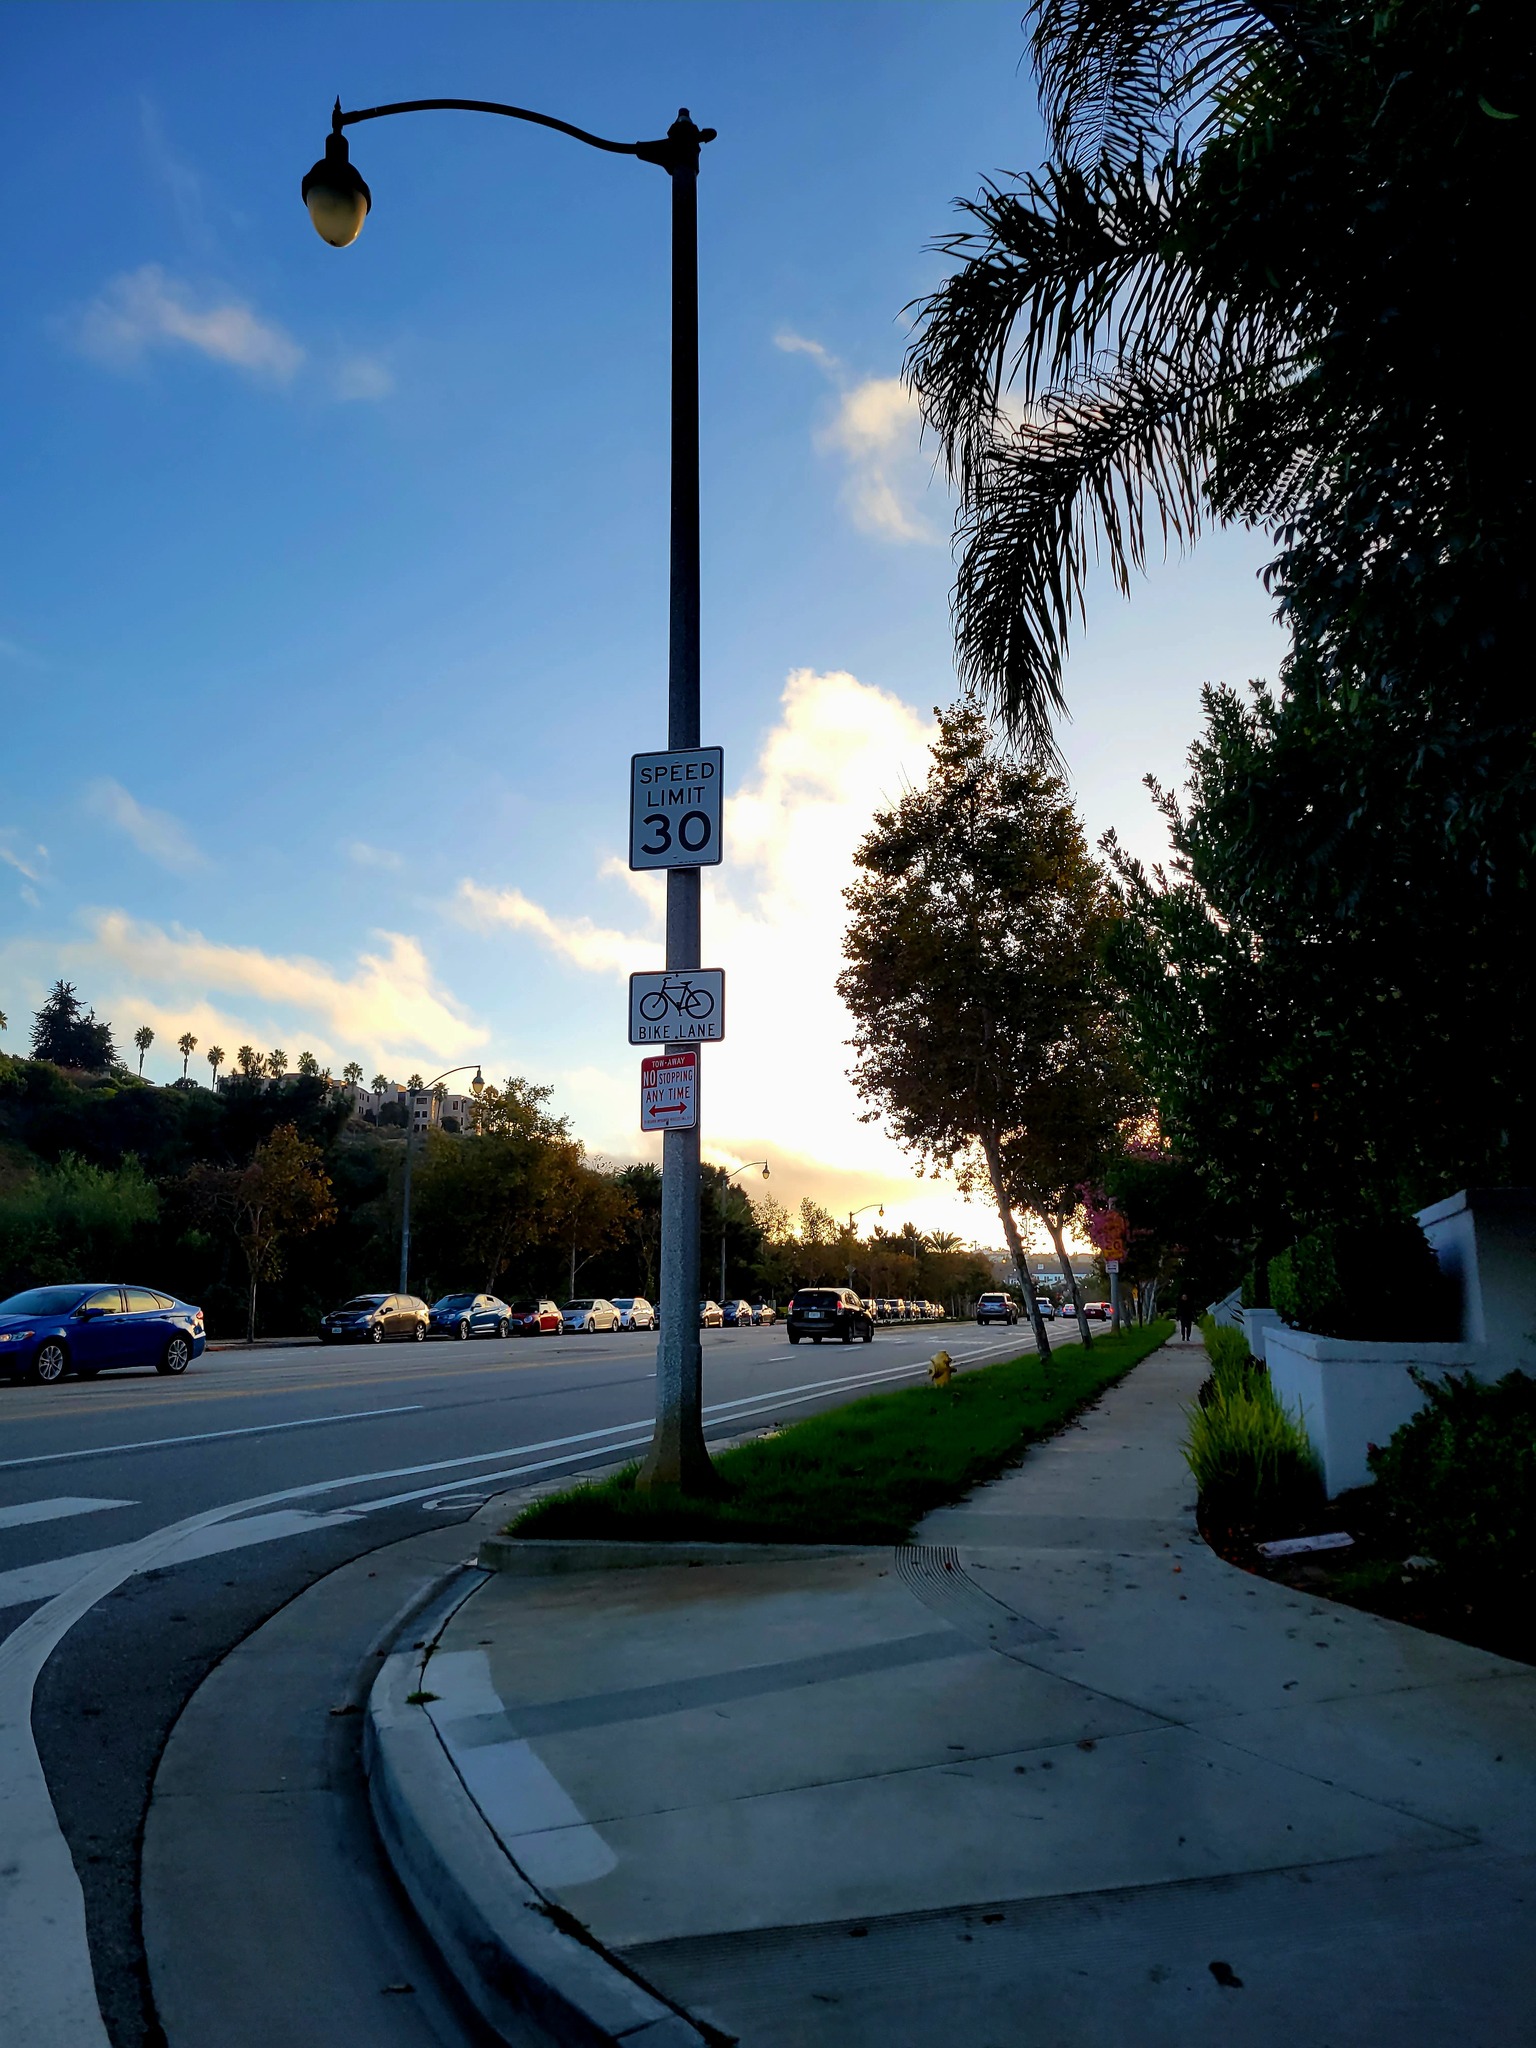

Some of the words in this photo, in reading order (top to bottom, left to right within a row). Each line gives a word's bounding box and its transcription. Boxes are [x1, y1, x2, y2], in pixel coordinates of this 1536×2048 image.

[640, 763, 714, 784] SPEED
[647, 786, 706, 807] LIMIT
[640, 810, 711, 854] 30
[639, 1026, 670, 1039] BIKE
[679, 1024, 715, 1037] LANE
[652, 1057, 685, 1068] TOW-AWAY
[643, 1070, 656, 1086] NO
[658, 1070, 693, 1084] STOPPING
[646, 1090, 664, 1103] ANY
[668, 1087, 690, 1100] TIME
